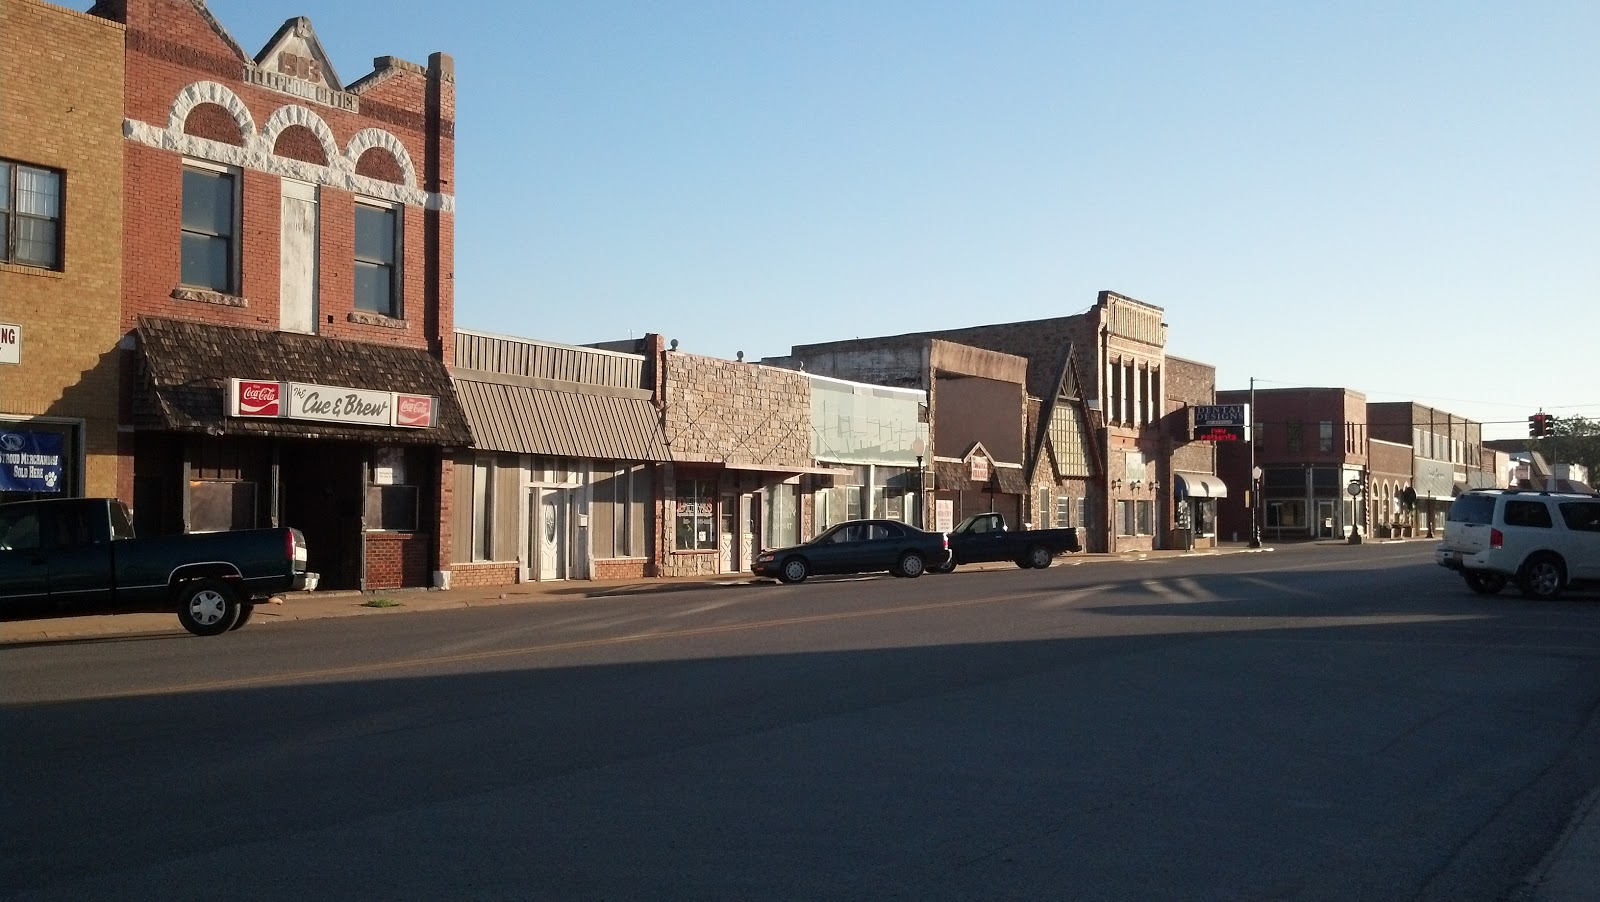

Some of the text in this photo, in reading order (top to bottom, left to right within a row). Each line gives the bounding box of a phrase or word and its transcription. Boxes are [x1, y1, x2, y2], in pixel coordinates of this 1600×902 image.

[302, 392, 388, 417] Cue & Brew
